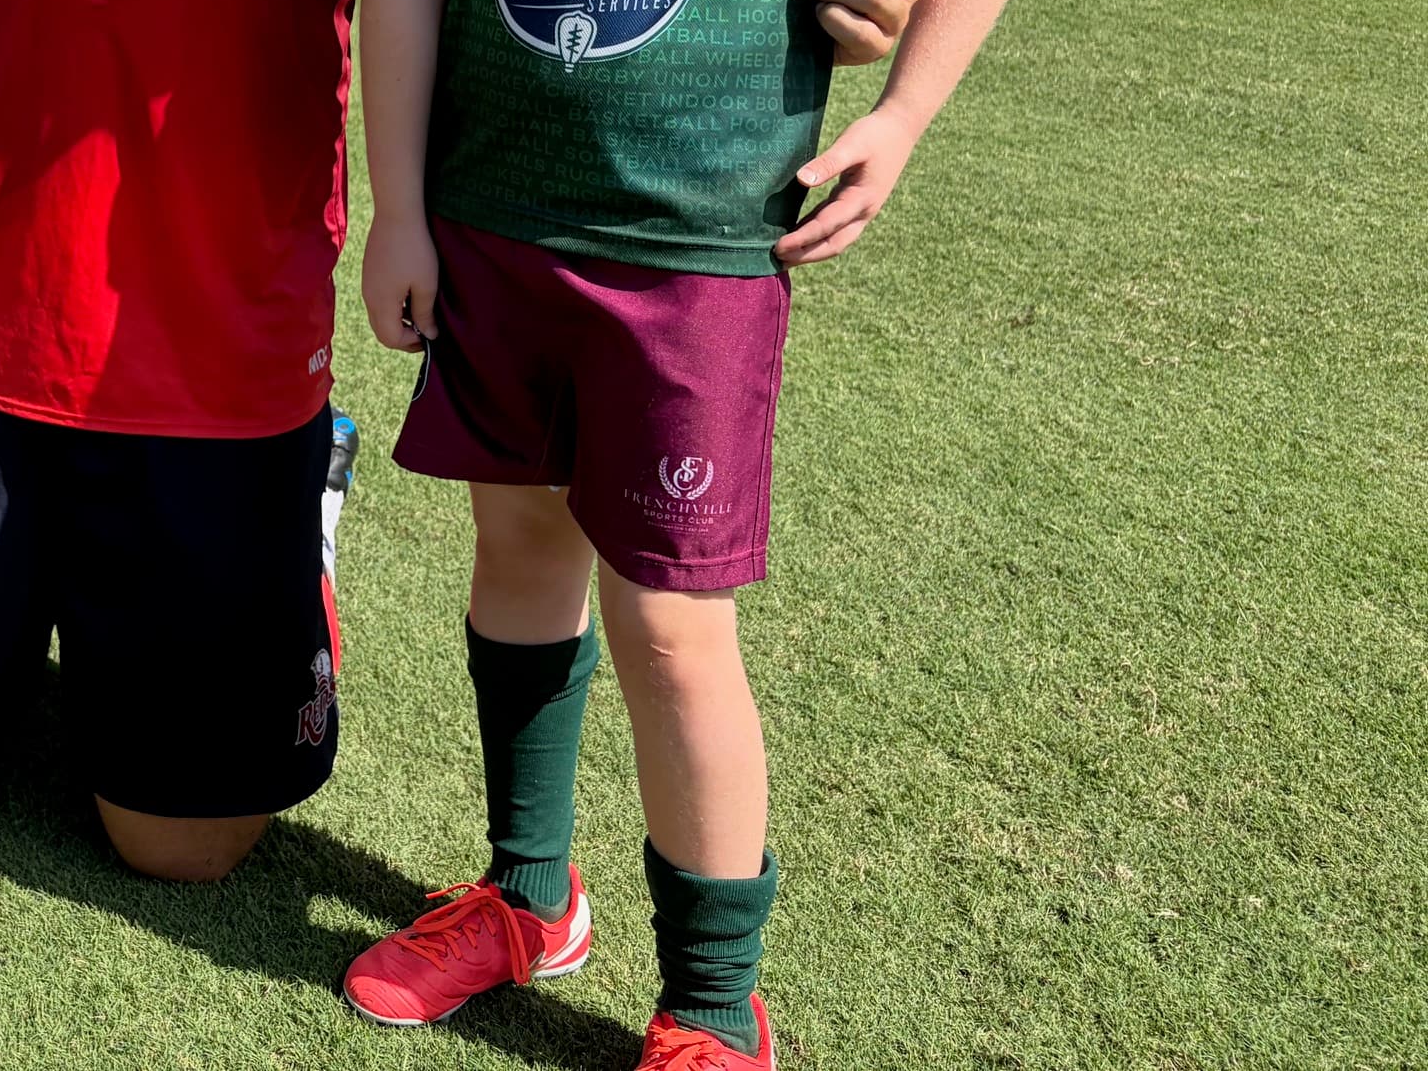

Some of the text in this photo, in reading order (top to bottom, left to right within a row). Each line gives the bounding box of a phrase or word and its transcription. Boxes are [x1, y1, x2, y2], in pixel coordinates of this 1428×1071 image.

[654, 71, 728, 89] UNION
[660, 91, 749, 111] INDOOR
[568, 107, 723, 131] BASKETBALL
[573, 126, 724, 154] BASKETBALL
[623, 488, 733, 515] FRENCHVILLE
[643, 509, 714, 525] SPORTS CLUB
